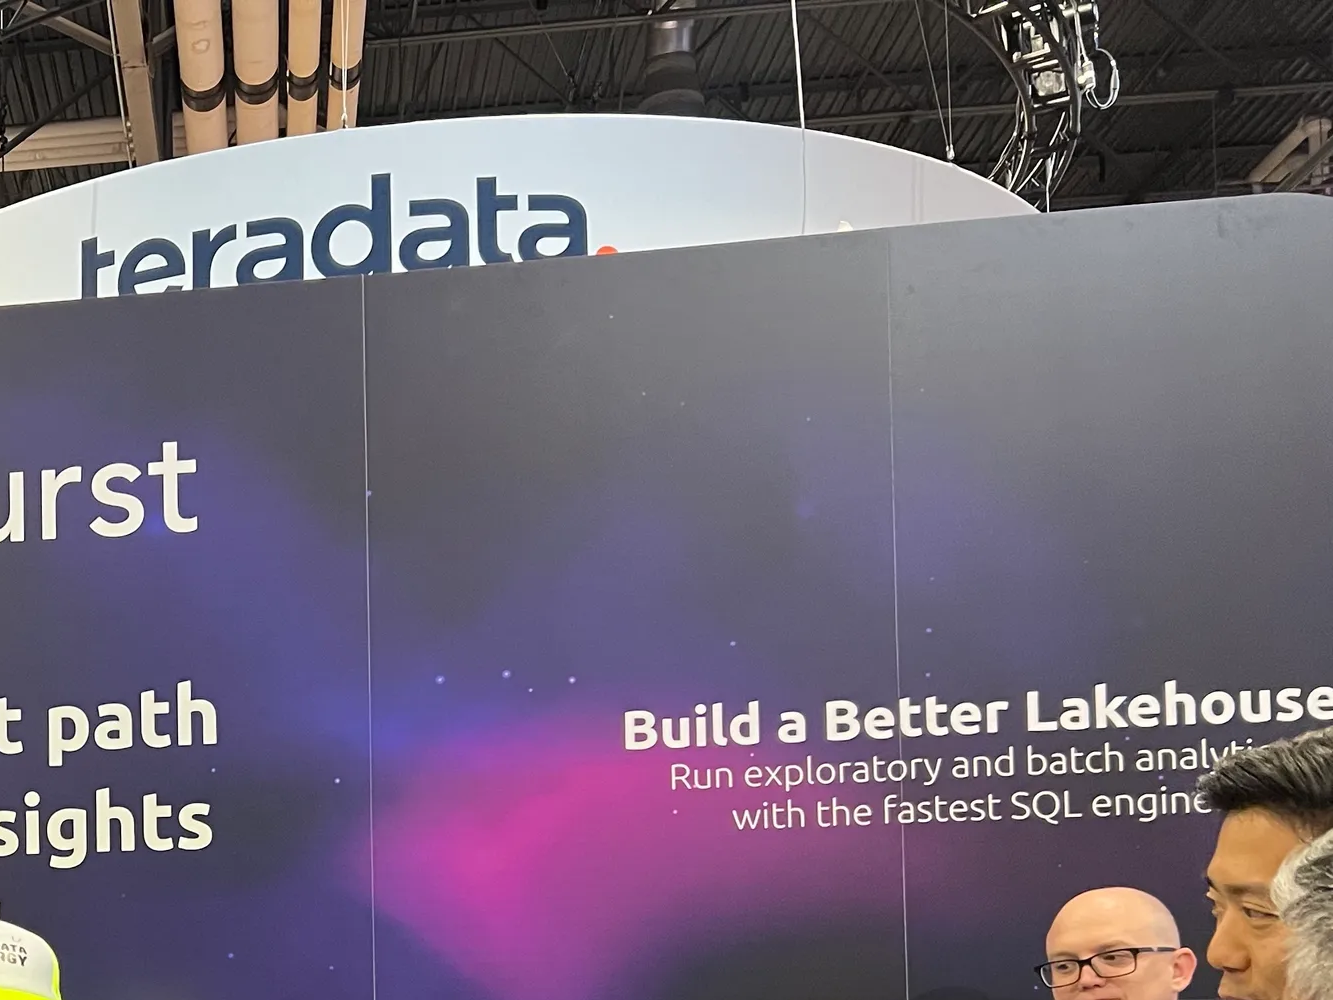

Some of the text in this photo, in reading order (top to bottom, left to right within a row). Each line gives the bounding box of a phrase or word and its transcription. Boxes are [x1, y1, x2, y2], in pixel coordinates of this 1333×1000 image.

[47, 680, 219, 767] path
[624, 679, 1333, 751] Build a Better Lakehouse
[670, 762, 734, 791] Run
[744, 755, 943, 792] exploratory
[952, 745, 1014, 778] and
[1027, 742, 1125, 777] batch
[732, 787, 1213, 831] with the fastest SQL engine
